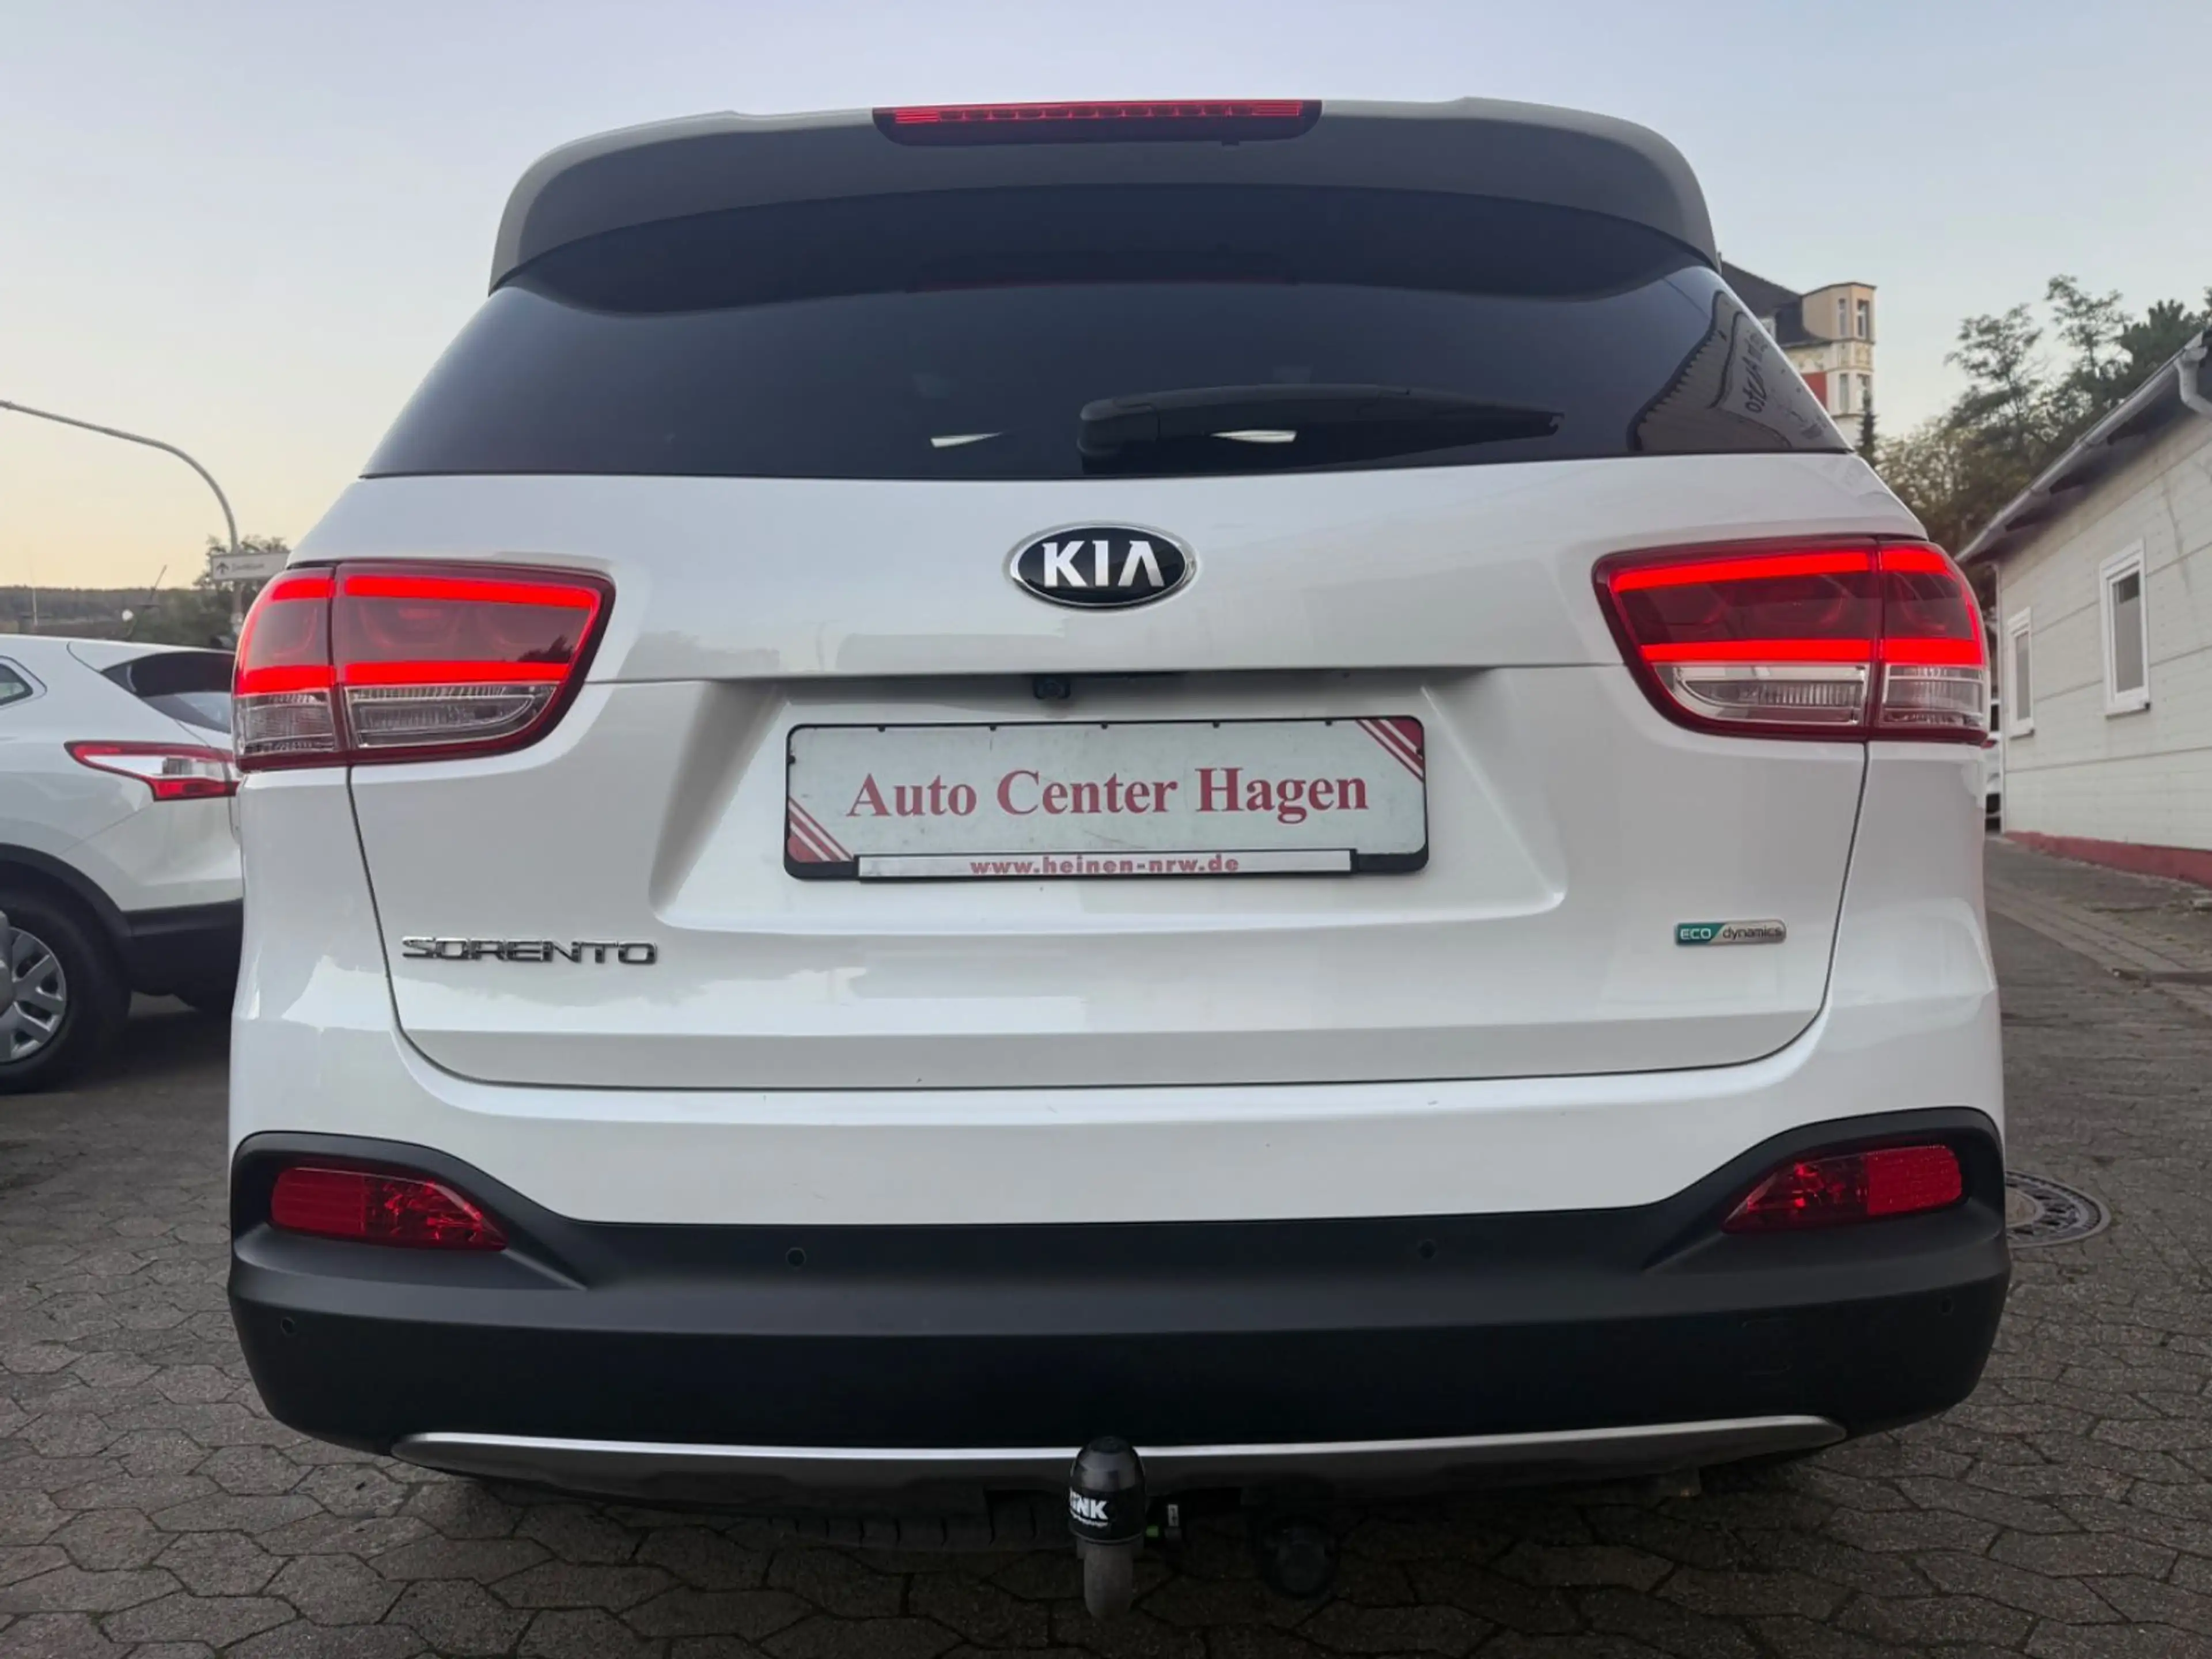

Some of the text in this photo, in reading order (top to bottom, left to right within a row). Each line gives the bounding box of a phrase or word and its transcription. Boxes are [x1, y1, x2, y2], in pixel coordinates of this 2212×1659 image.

[1042, 540, 1165, 588] KIA
[846, 767, 1369, 824] Auto Center Hagen
[970, 854, 1240, 874] www.heinen-nrw.de
[1680, 925, 1782, 940] ECO dynamics
[402, 937, 657, 964] SORENTO
